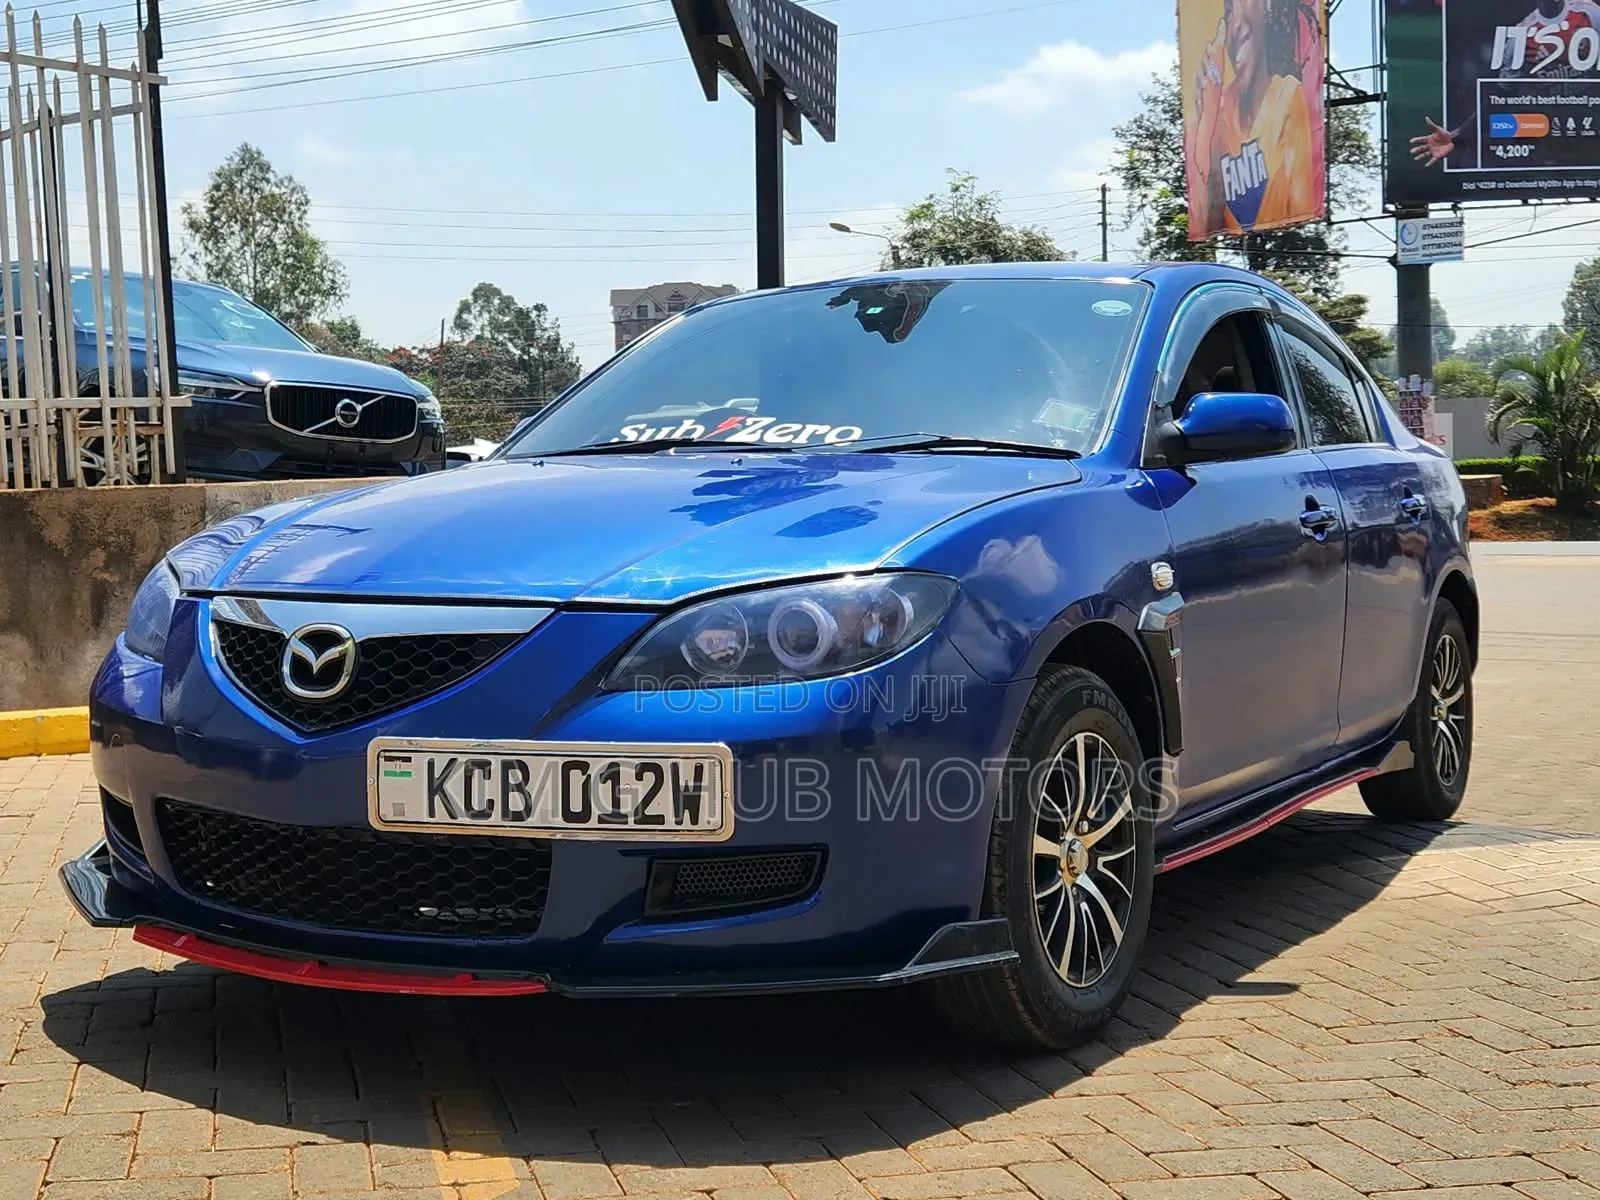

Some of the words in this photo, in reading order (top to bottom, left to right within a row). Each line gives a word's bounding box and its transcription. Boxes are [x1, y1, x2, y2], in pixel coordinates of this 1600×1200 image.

[1568, 27, 1600, 71] O
[1489, 95, 1505, 105] The
[1506, 95, 1536, 105] world's
[1537, 95, 1556, 105] best
[1556, 95, 1588, 105] football
[1495, 145, 1529, 159] 4,200
[1220, 141, 1268, 201] FANTA
[609, 419, 705, 442] Sub
[725, 416, 863, 446] Zero
[427, 757, 534, 822] KCB
[561, 760, 704, 826] 012W
